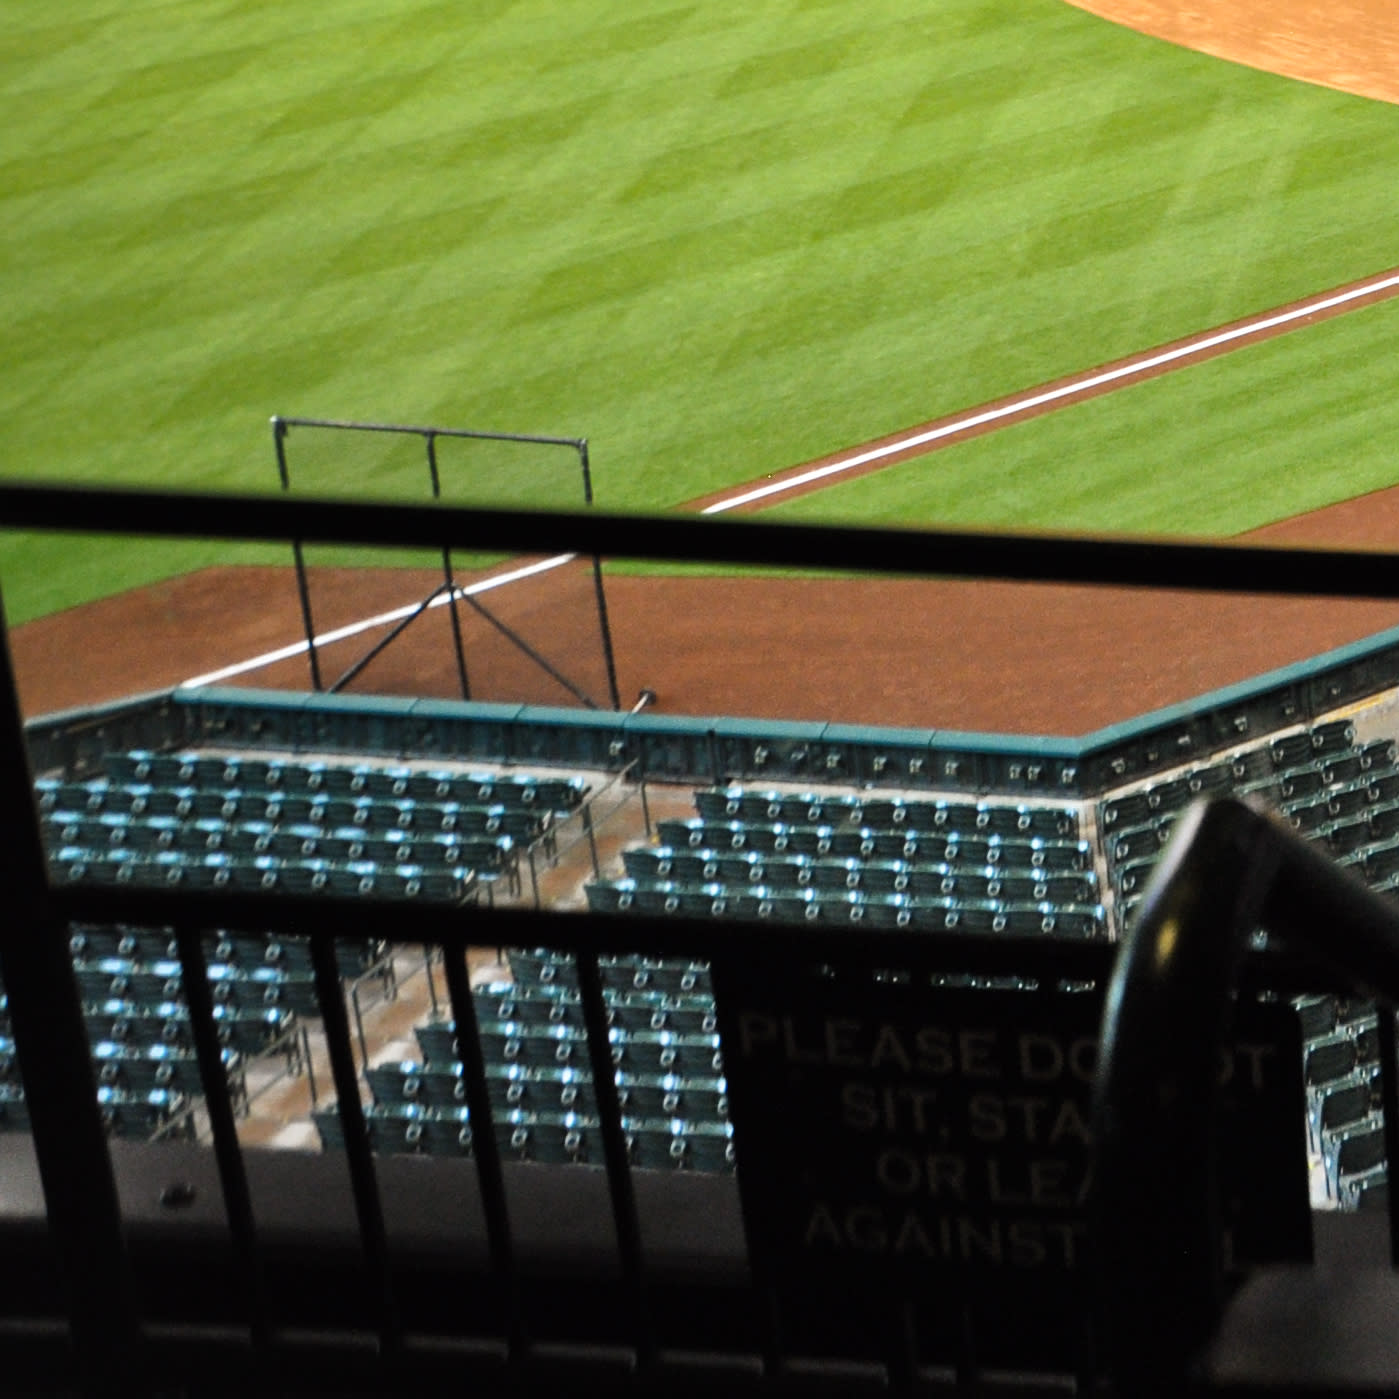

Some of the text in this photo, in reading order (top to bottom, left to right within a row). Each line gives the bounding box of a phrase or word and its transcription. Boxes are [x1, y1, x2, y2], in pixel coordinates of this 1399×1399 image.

[737, 1011, 1002, 1079] PLEASE
[840, 1082, 1096, 1147] SIT, STA
[875, 1147, 968, 1202] OR
[802, 1202, 1090, 1270] AGAINST
